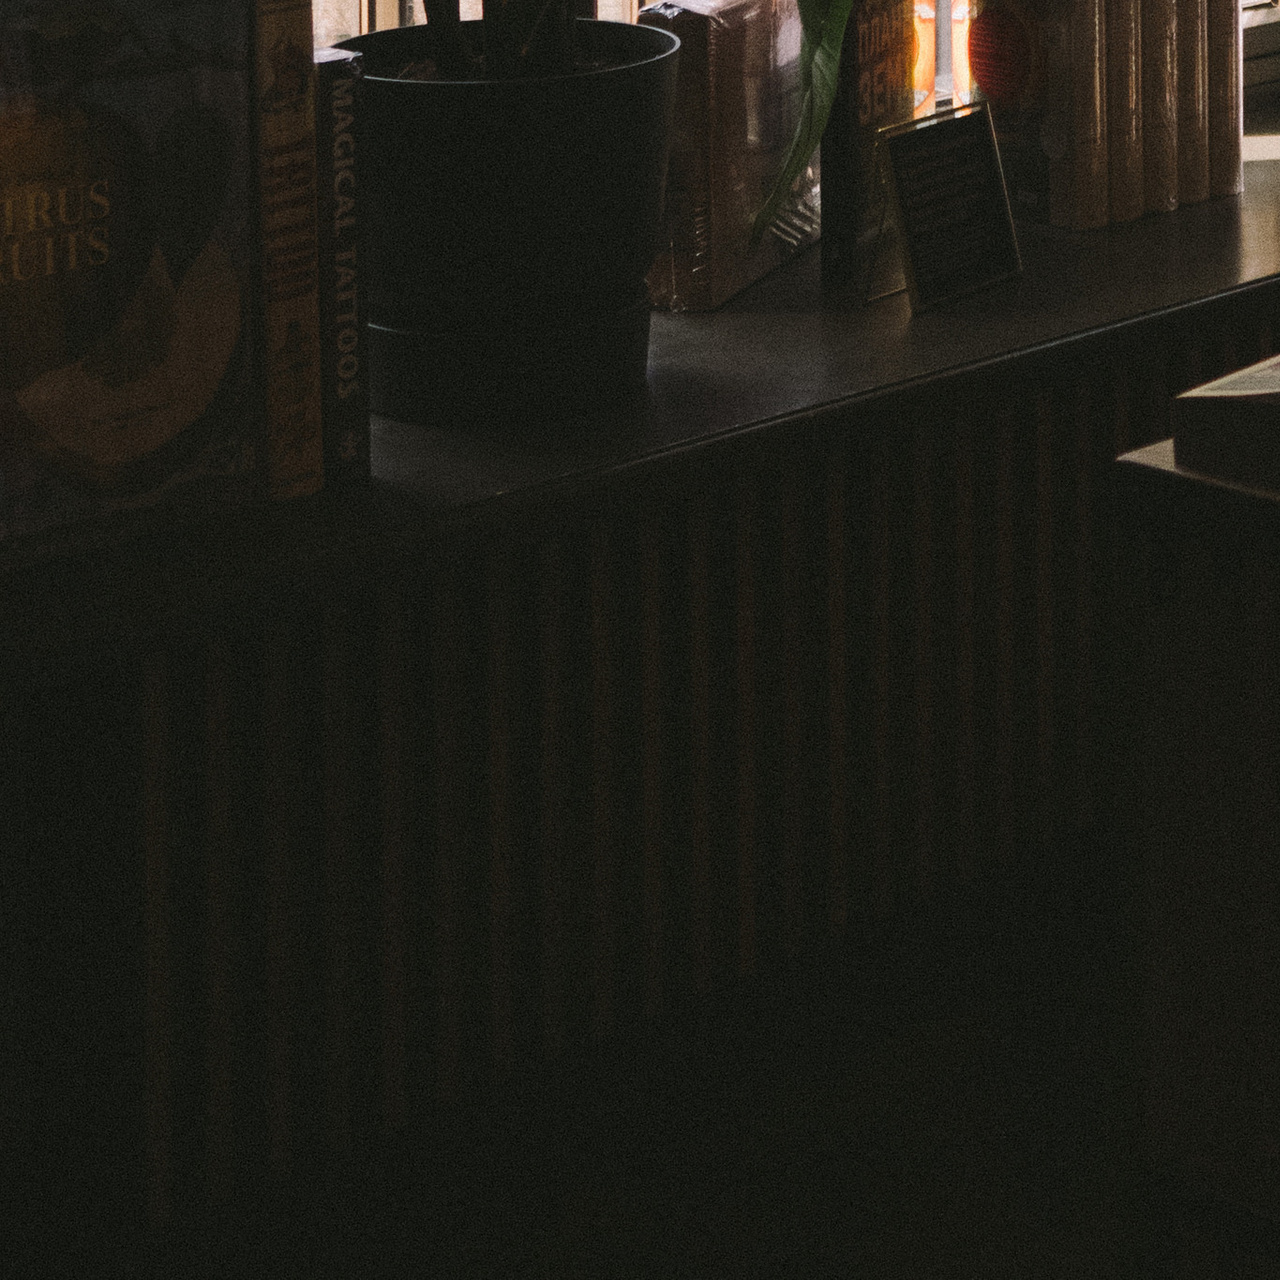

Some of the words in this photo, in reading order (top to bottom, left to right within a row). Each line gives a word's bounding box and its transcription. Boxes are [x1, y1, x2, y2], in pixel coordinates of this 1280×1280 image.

[330, 76, 357, 239] MAGICAL
[0, 226, 110, 283] UITS
[333, 243, 361, 402] TATTOOS
